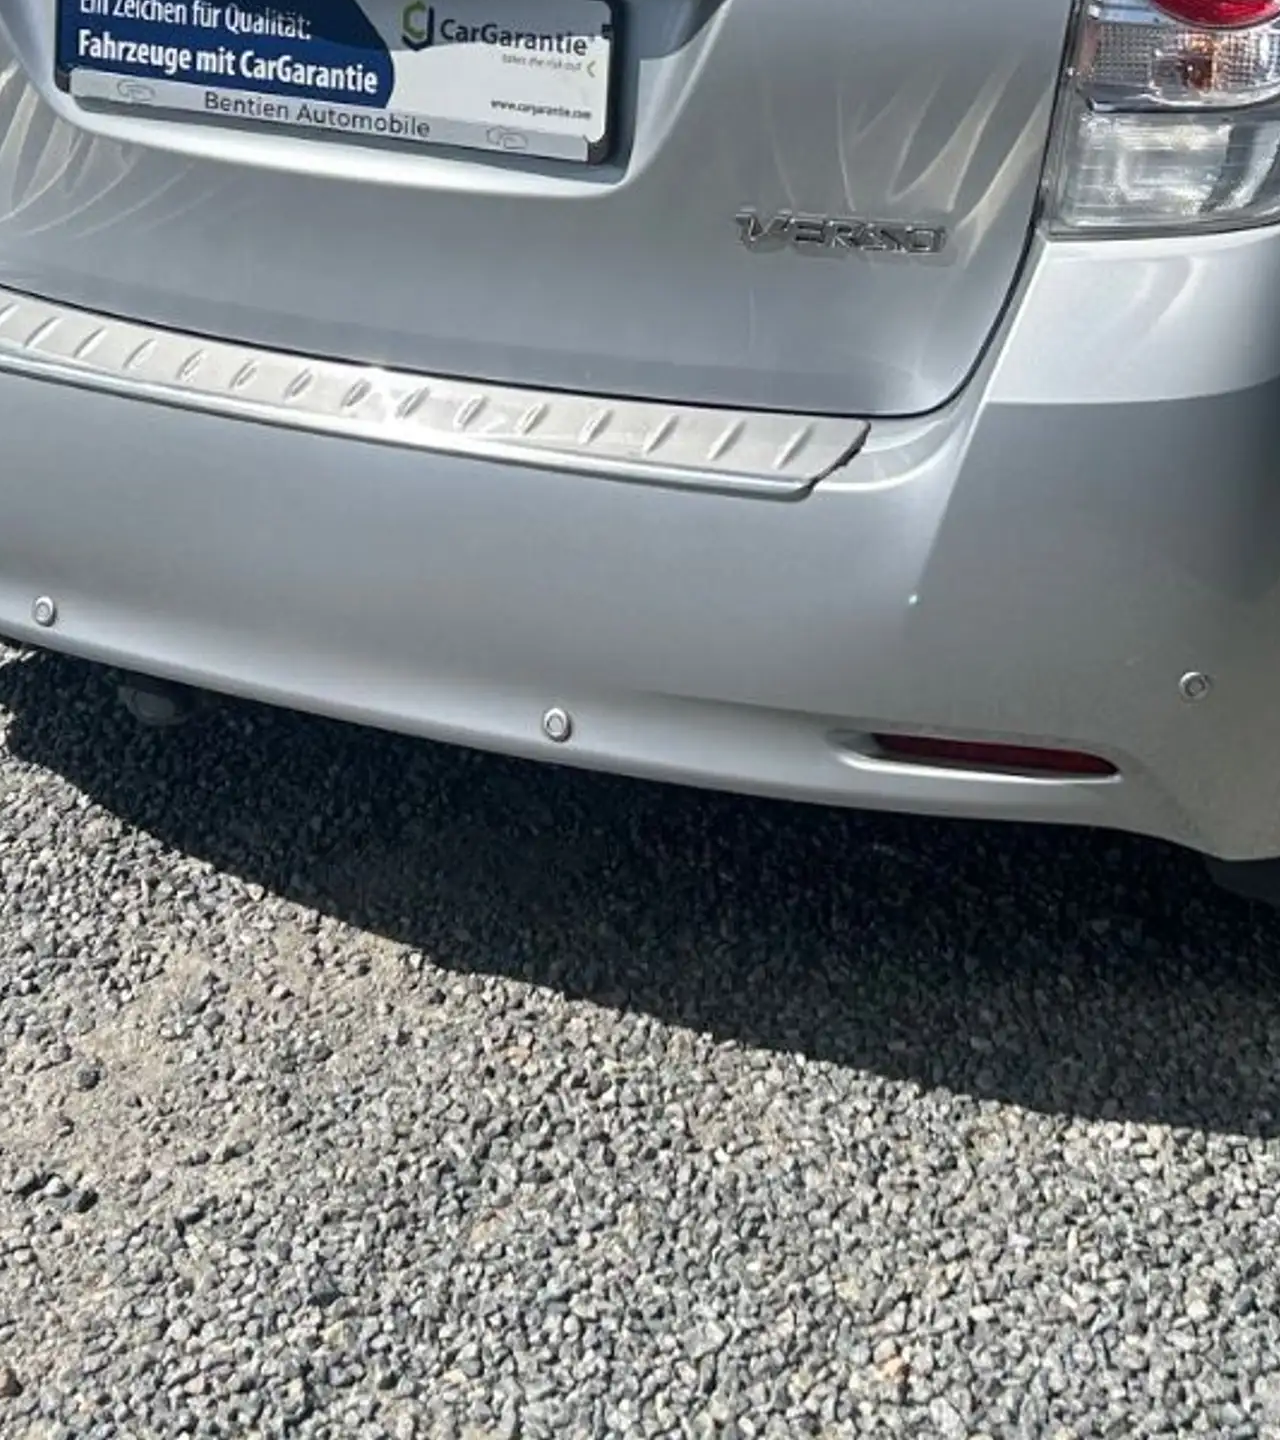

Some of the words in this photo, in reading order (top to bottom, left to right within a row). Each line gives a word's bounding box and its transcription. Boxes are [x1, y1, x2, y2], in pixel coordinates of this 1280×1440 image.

[224, 3, 312, 41] Qualität:
[439, 18, 589, 57] CarGarantie
[77, 28, 191, 76] Fahrzeuge
[195, 45, 236, 77] mit
[239, 50, 378, 94] CarGarantie
[204, 90, 289, 121] Bentien
[294, 104, 431, 138] Automobile
